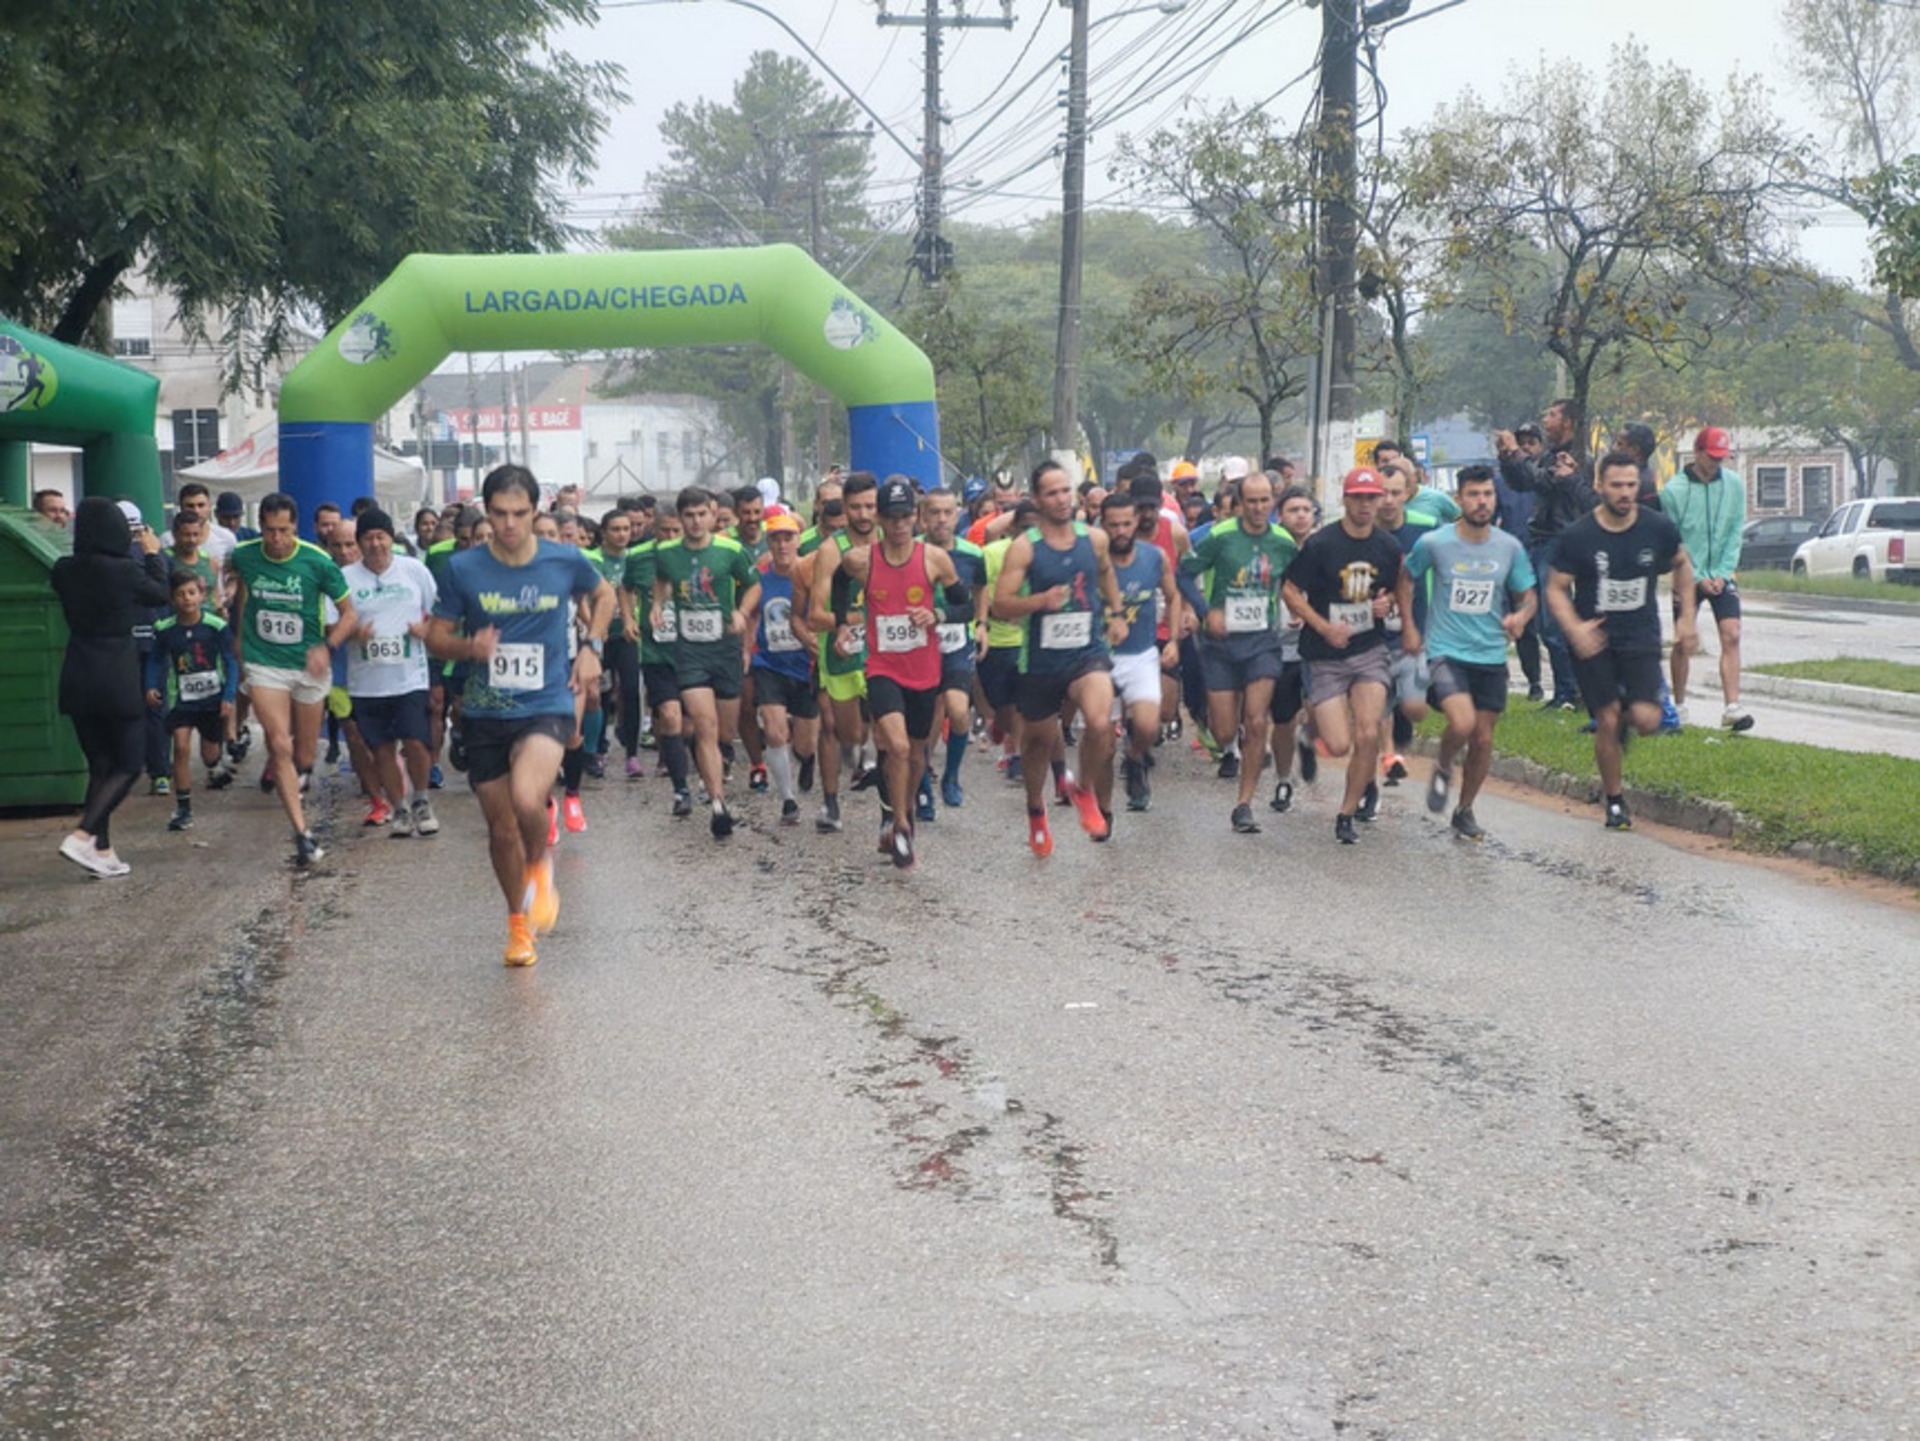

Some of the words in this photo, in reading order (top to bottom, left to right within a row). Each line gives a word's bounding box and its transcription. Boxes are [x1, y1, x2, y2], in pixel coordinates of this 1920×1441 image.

[465, 283, 747, 313] LARGADA/CHEGADA
[1454, 588, 1490, 606] 927
[262, 618, 296, 636] 916
[886, 624, 919, 641] 598
[369, 640, 402, 658] 963
[493, 654, 539, 677] 915
